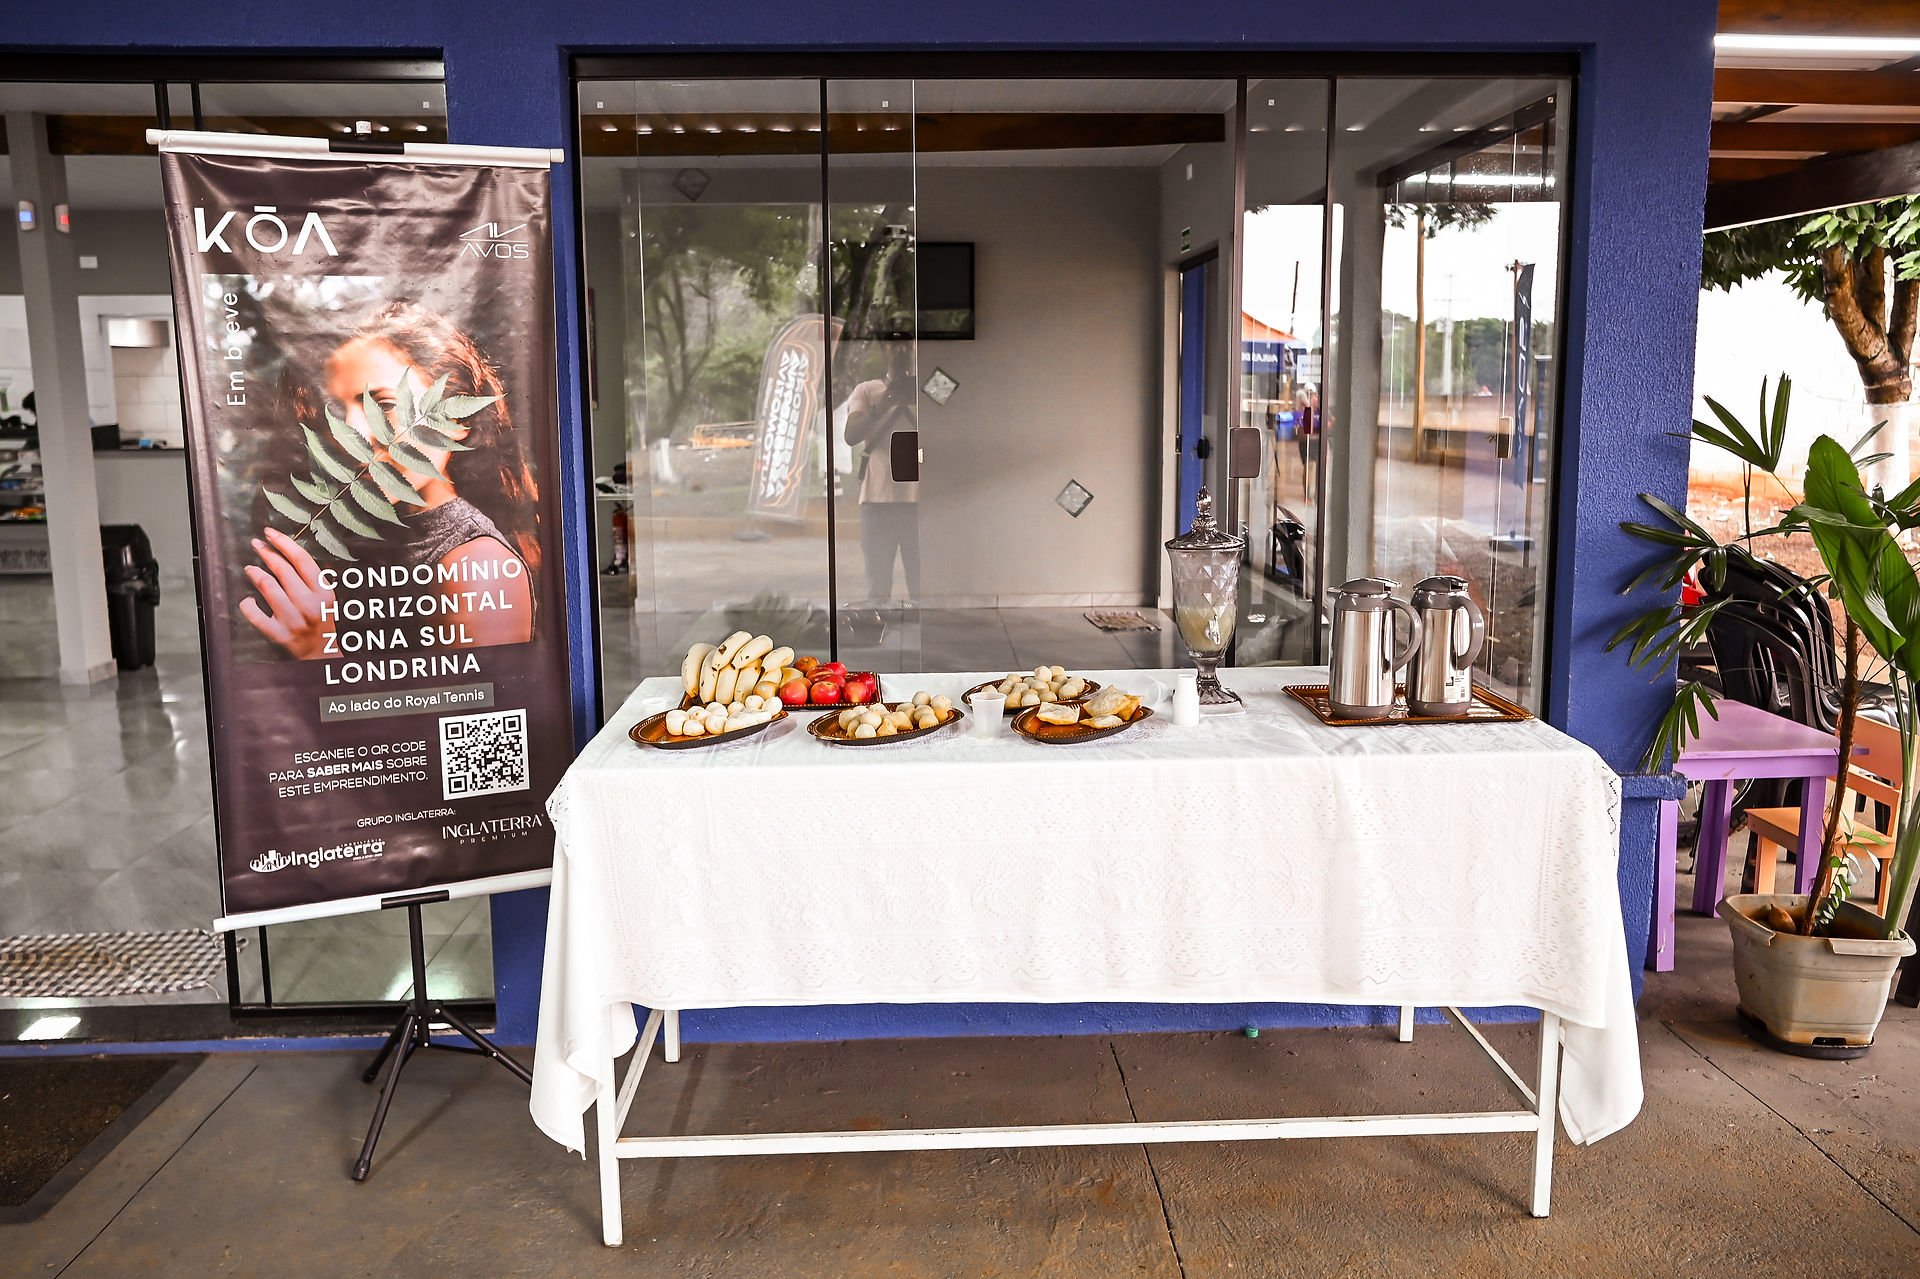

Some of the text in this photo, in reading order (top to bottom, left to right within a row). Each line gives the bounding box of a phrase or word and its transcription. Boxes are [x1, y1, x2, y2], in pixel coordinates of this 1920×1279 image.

[460, 242, 529, 259] AVOS
[226, 370, 247, 406] Em
[317, 556, 522, 590] CONDOMÍNIO
[320, 590, 513, 622] HORIZONTAL
[322, 623, 474, 654] ZONA SUL
[325, 653, 481, 685] LONDRINA
[328, 688, 485, 714] Ao lado do Royal Tennis
[294, 740, 426, 764] ESCANEIE O QR CODE
[269, 755, 428, 783] PARA SABER MAIS SOBRE
[278, 770, 429, 798] ESTE EMPREENDIMENTO.
[356, 807, 456, 828] GRUPO INGLATERRA:
[442, 814, 543, 840] INGLATERRA
[460, 831, 528, 845] PREMIUM
[291, 840, 383, 869] Inglaterra
